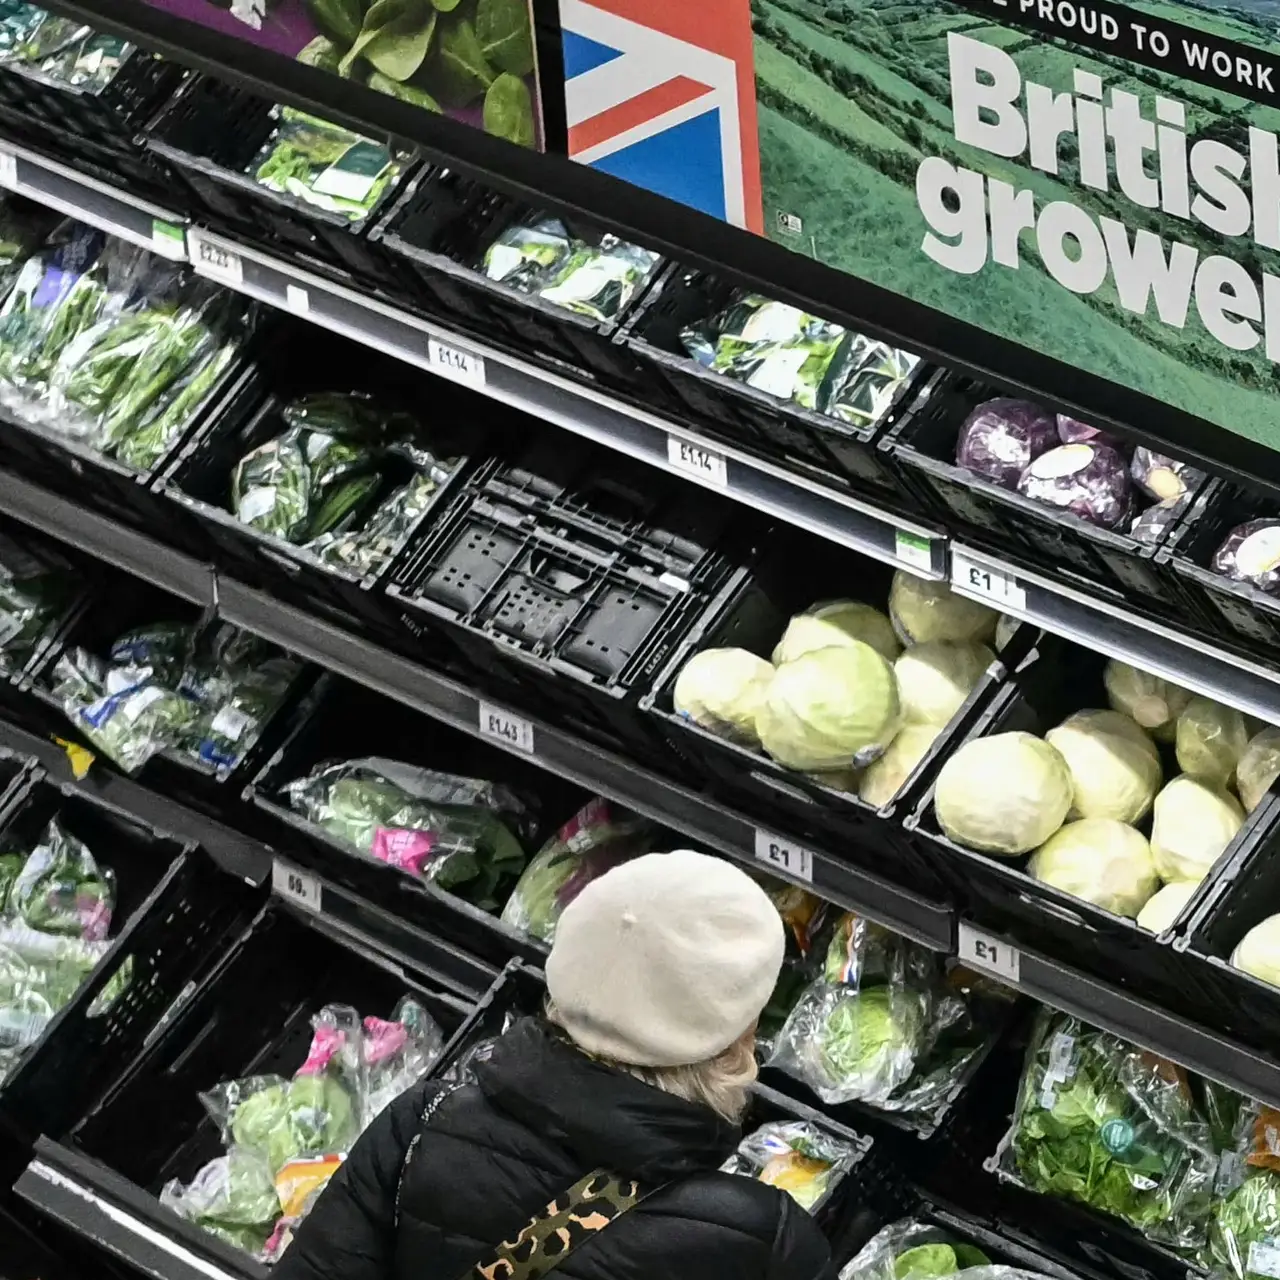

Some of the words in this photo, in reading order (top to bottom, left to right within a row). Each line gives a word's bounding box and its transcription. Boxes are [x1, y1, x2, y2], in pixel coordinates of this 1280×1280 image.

[1020, 0, 1119, 41] PROUD
[1130, 23, 1170, 58] TO
[1182, 39, 1276, 93] WORK
[969, 567, 991, 591] £1
[769, 841, 791, 867] £1
[975, 939, 998, 965] £1
